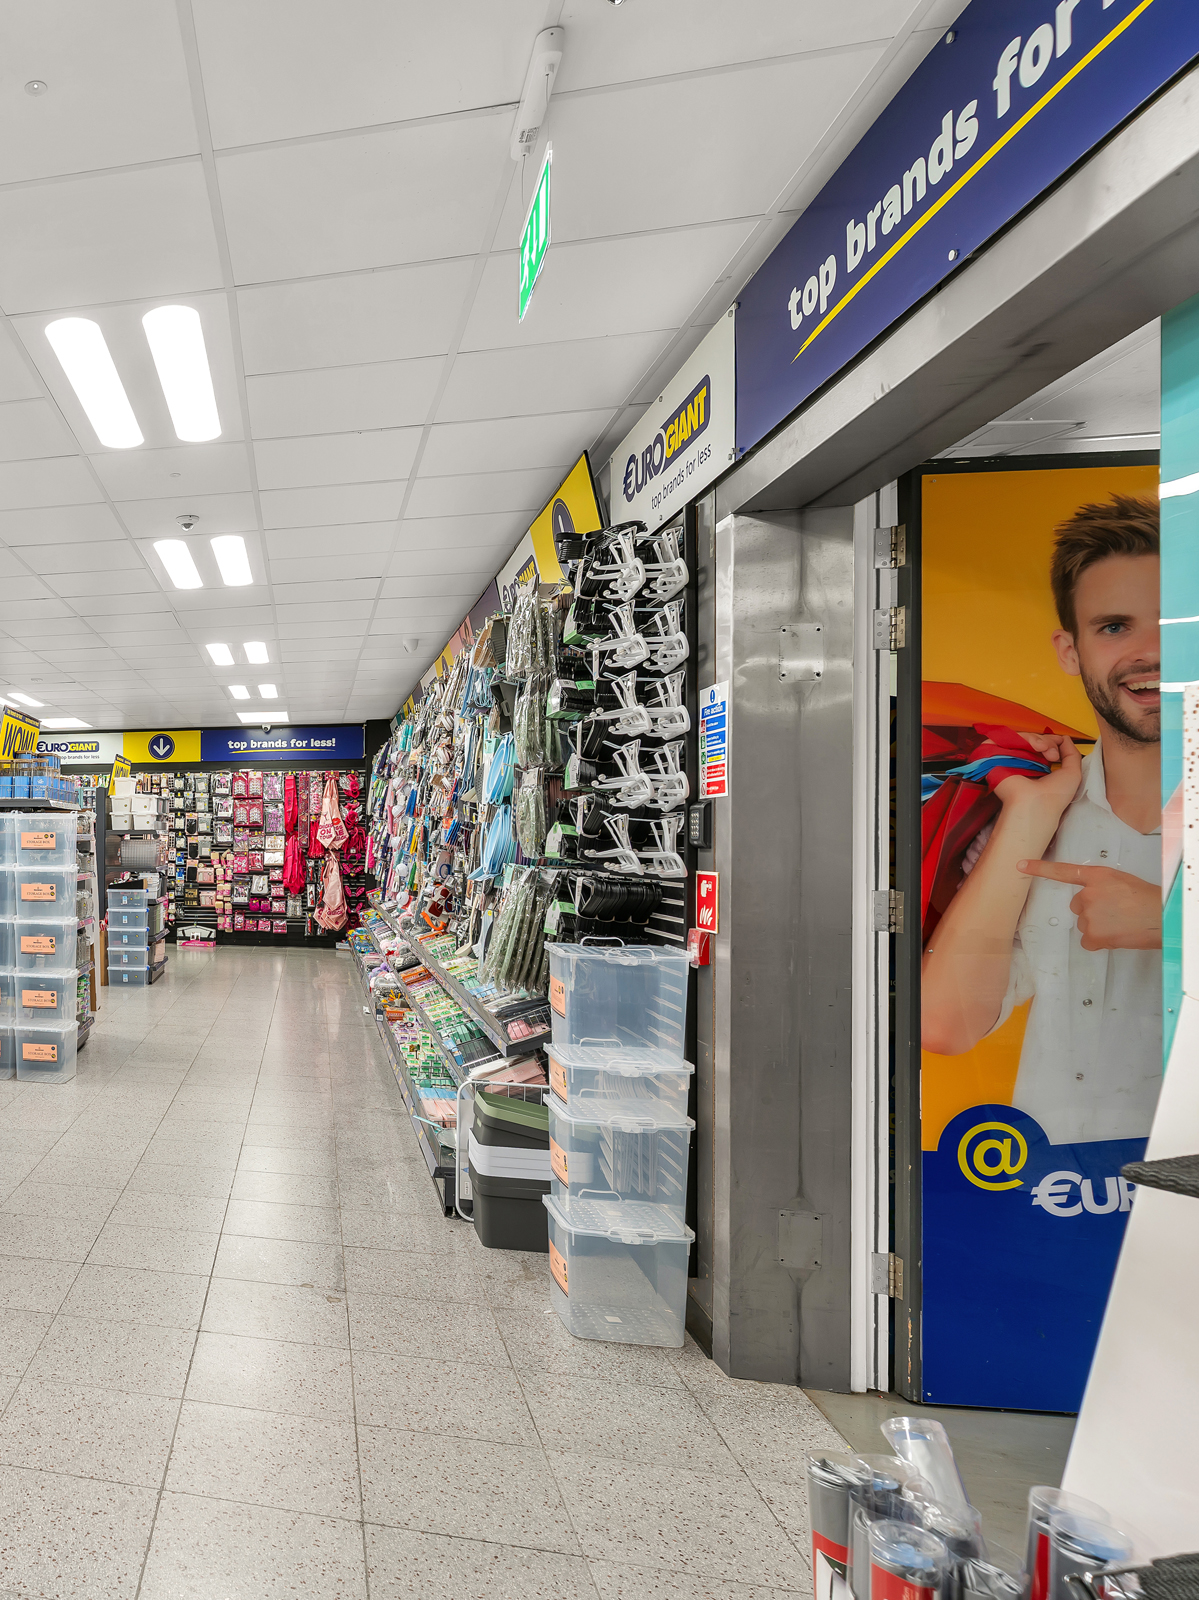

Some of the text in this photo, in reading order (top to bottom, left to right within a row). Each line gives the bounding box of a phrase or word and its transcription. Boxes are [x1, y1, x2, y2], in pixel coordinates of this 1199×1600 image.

[788, 0, 1081, 330] top brands for
[651, 444, 712, 510] top brands for less
[228, 738, 336, 750] top brands for less!
[957, 1121, 1028, 1192] @
